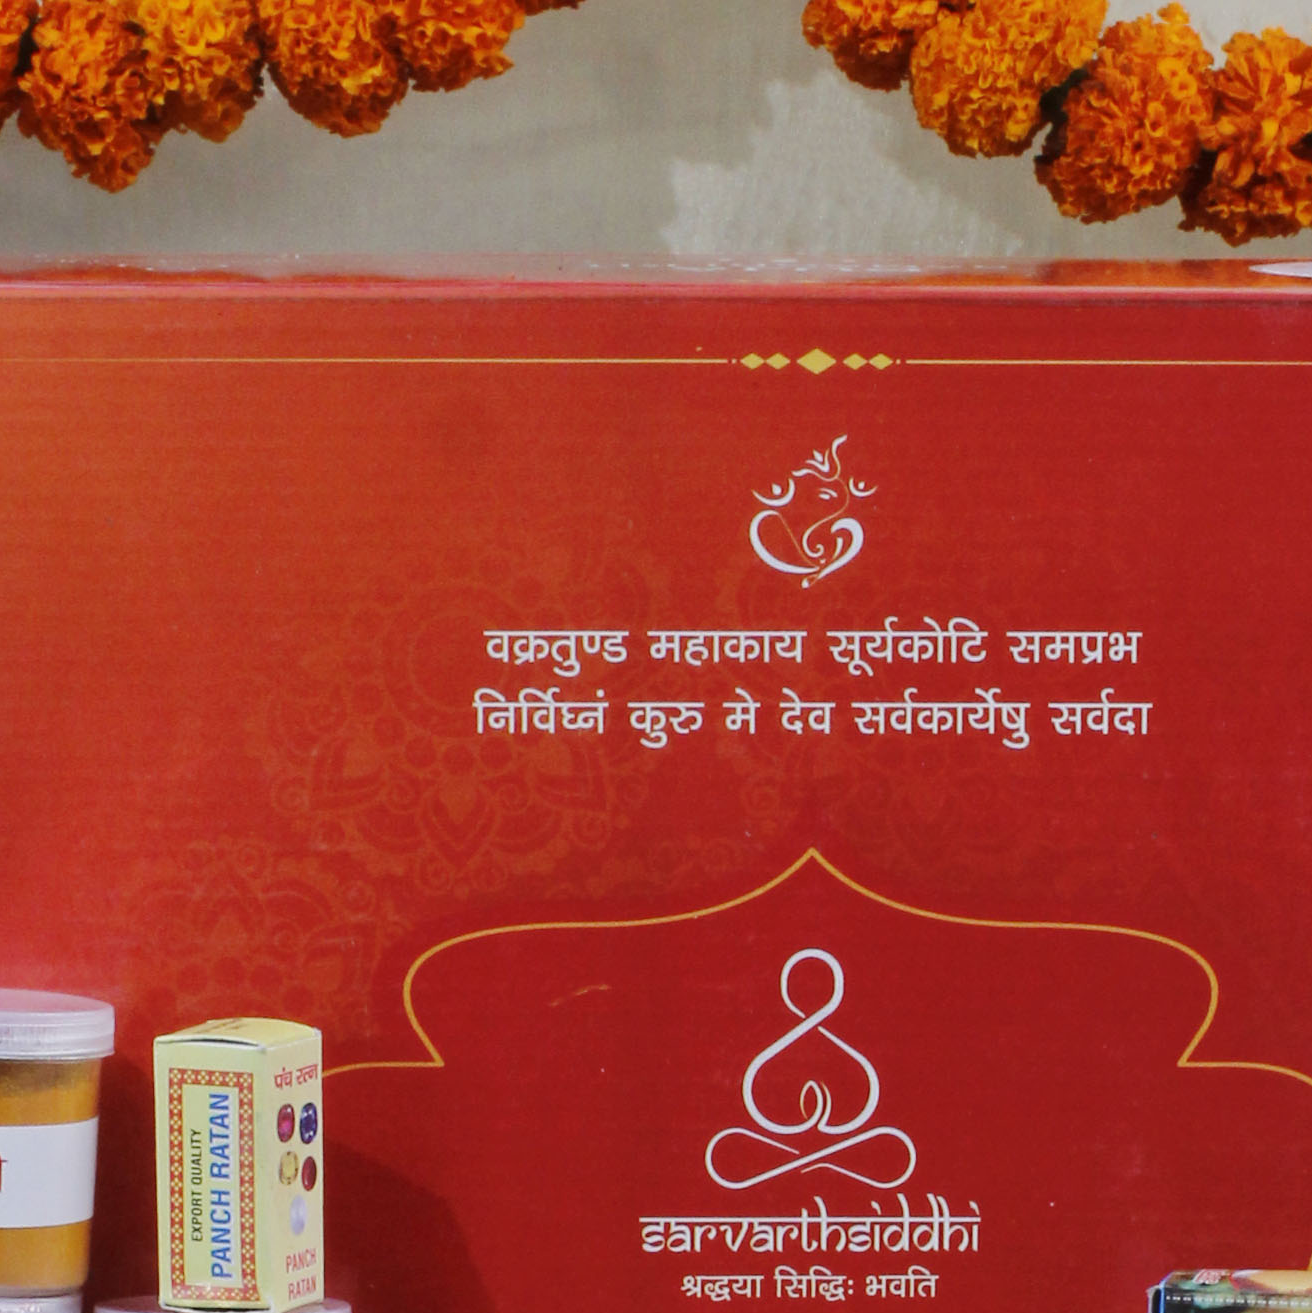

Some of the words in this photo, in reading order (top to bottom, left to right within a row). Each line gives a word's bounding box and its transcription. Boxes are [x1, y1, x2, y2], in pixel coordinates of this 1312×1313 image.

[485, 628, 628, 677] वक्रतुण्ड
[649, 628, 807, 665] महाकाय
[828, 616, 988, 676] सूर्यकोटि
[1008, 628, 1142, 665] समप्रभ
[473, 687, 610, 736] निर्विघ्नं
[628, 699, 703, 749] कुरु
[723, 689, 761, 736] मे
[780, 689, 836, 736] देव
[853, 687, 1030, 749] सर्वकार्येषु
[1050, 687, 1152, 736] सर्वदा
[274, 1067, 294, 1090] पंच
[190, 1128, 203, 1187] QUALITY
[209, 1092, 232, 1179] RATAN
[191, 1191, 204, 1242] EXPORT
[210, 1188, 233, 1280] PANCH
[638, 1193, 982, 1254] sarvarthsiddhi
[285, 1248, 318, 1274] PANCH
[287, 1275, 318, 1301] RATAN
[680, 1273, 764, 1302] श्रद्धया
[864, 1265, 940, 1301] भवति
